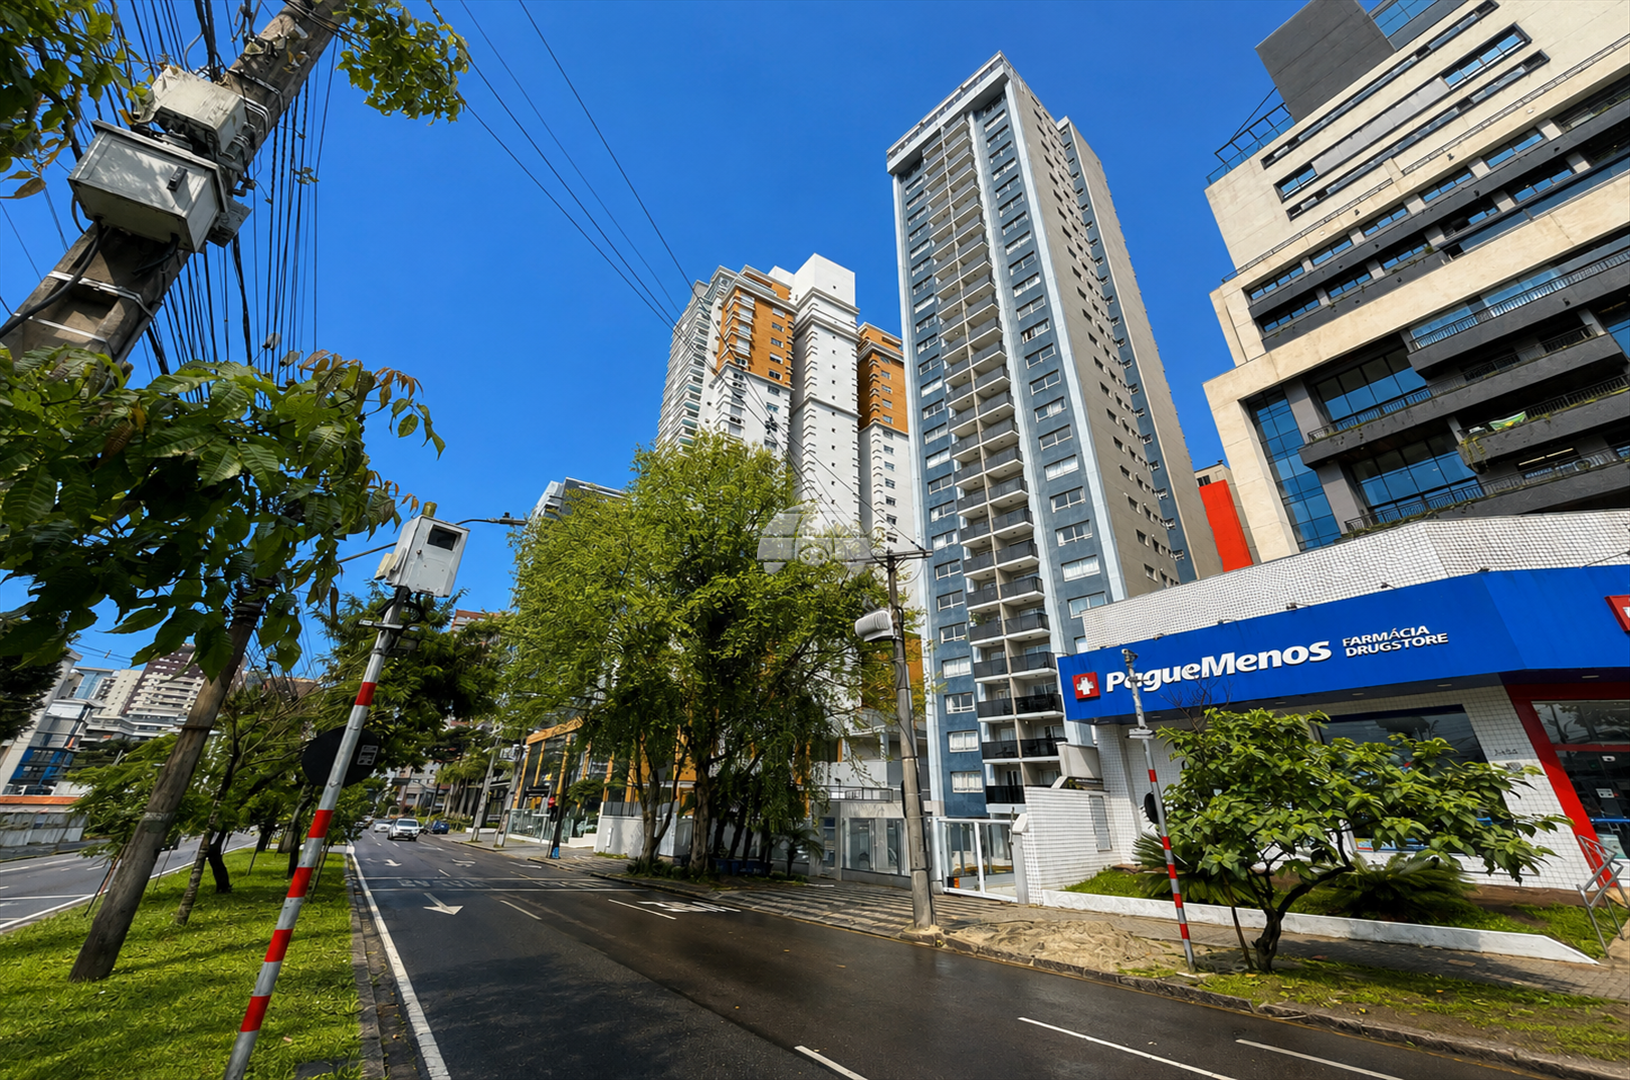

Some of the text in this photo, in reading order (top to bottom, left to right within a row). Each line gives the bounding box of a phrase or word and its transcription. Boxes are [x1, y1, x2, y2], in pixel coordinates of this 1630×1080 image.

[1343, 626, 1430, 647] FARMÁCIA
[1345, 633, 1449, 657] DRUGSTORE
[1106, 641, 1332, 692] PagueMenos
